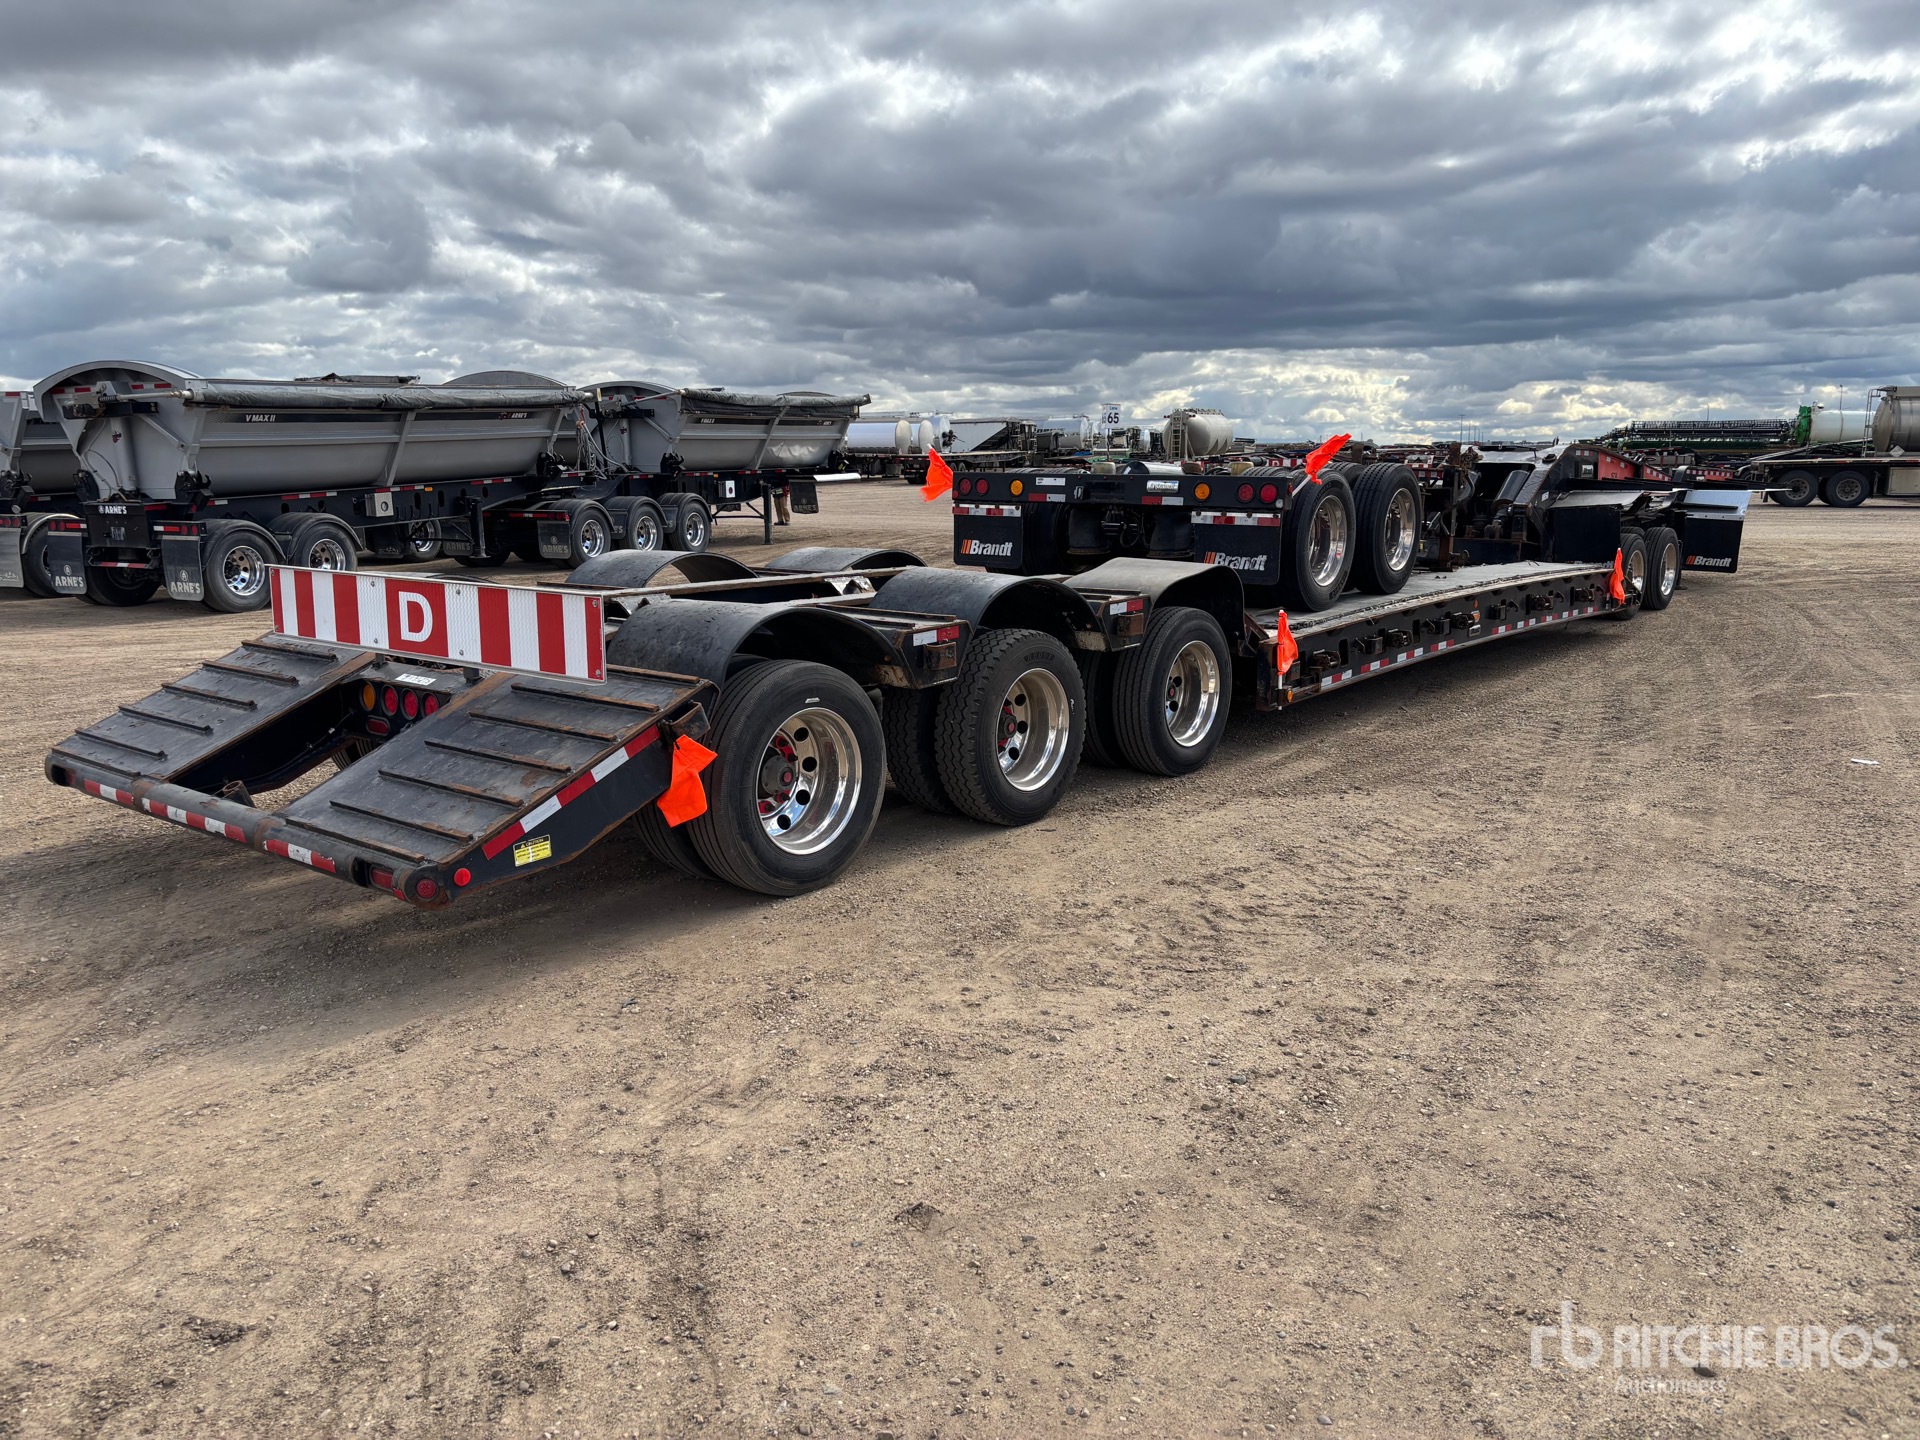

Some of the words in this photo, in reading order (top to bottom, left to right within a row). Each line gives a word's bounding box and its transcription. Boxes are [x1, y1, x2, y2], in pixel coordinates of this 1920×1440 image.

[1107, 412, 1120, 424] 65
[104, 505, 128, 515] ARNE'S
[542, 544, 569, 554] ARNE'S
[969, 540, 1013, 557] Brandt
[1213, 552, 1267, 571] Brandt
[1694, 556, 1732, 568] Brandt
[55, 576, 84, 588] ARNE'S
[170, 581, 201, 594] ARNE'S
[398, 591, 433, 643] D
